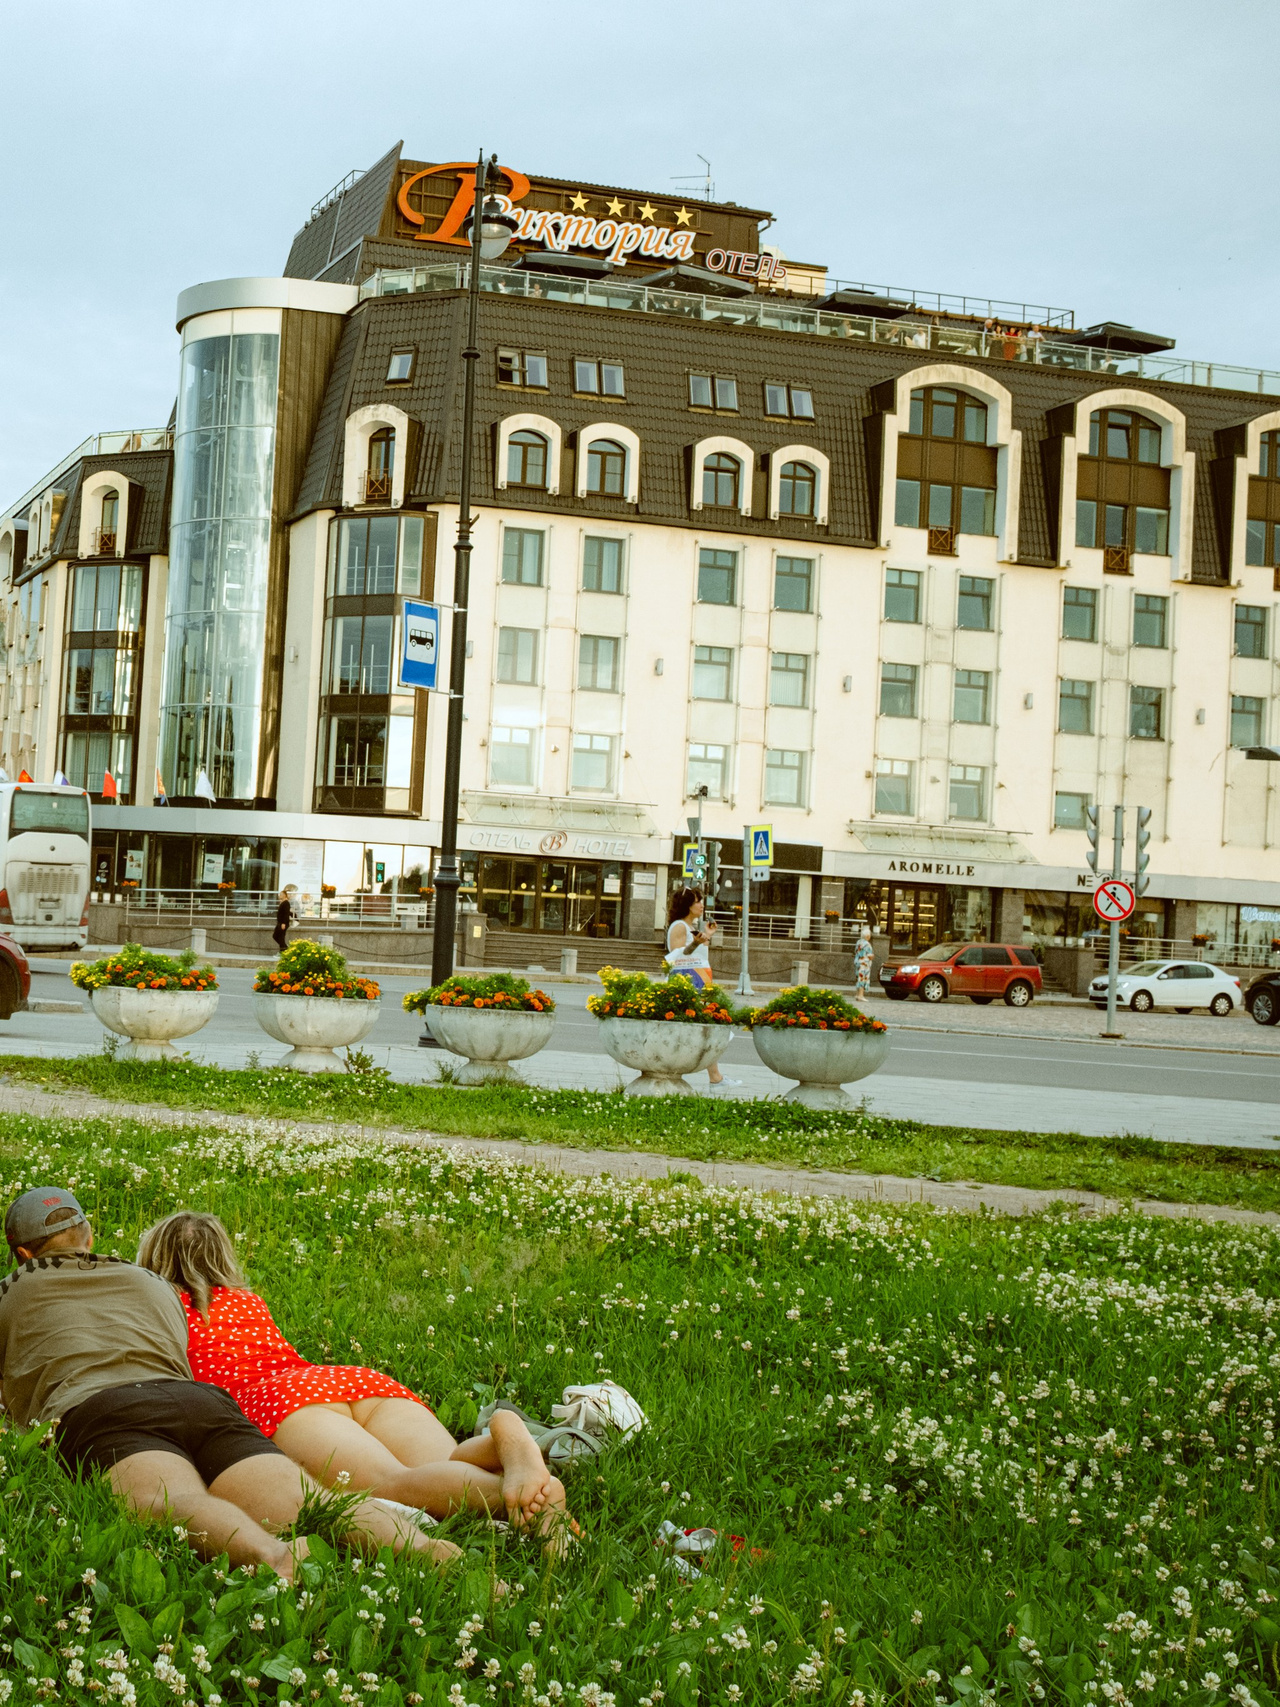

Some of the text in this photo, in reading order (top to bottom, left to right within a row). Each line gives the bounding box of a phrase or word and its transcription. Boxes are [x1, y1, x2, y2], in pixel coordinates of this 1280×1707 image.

[706, 248, 788, 280] ОТЕЛЬ
[469, 830, 531, 850] ОТЕЛЬ
[573, 837, 633, 857] HOTEL
[888, 860, 975, 876] AROMELLE
